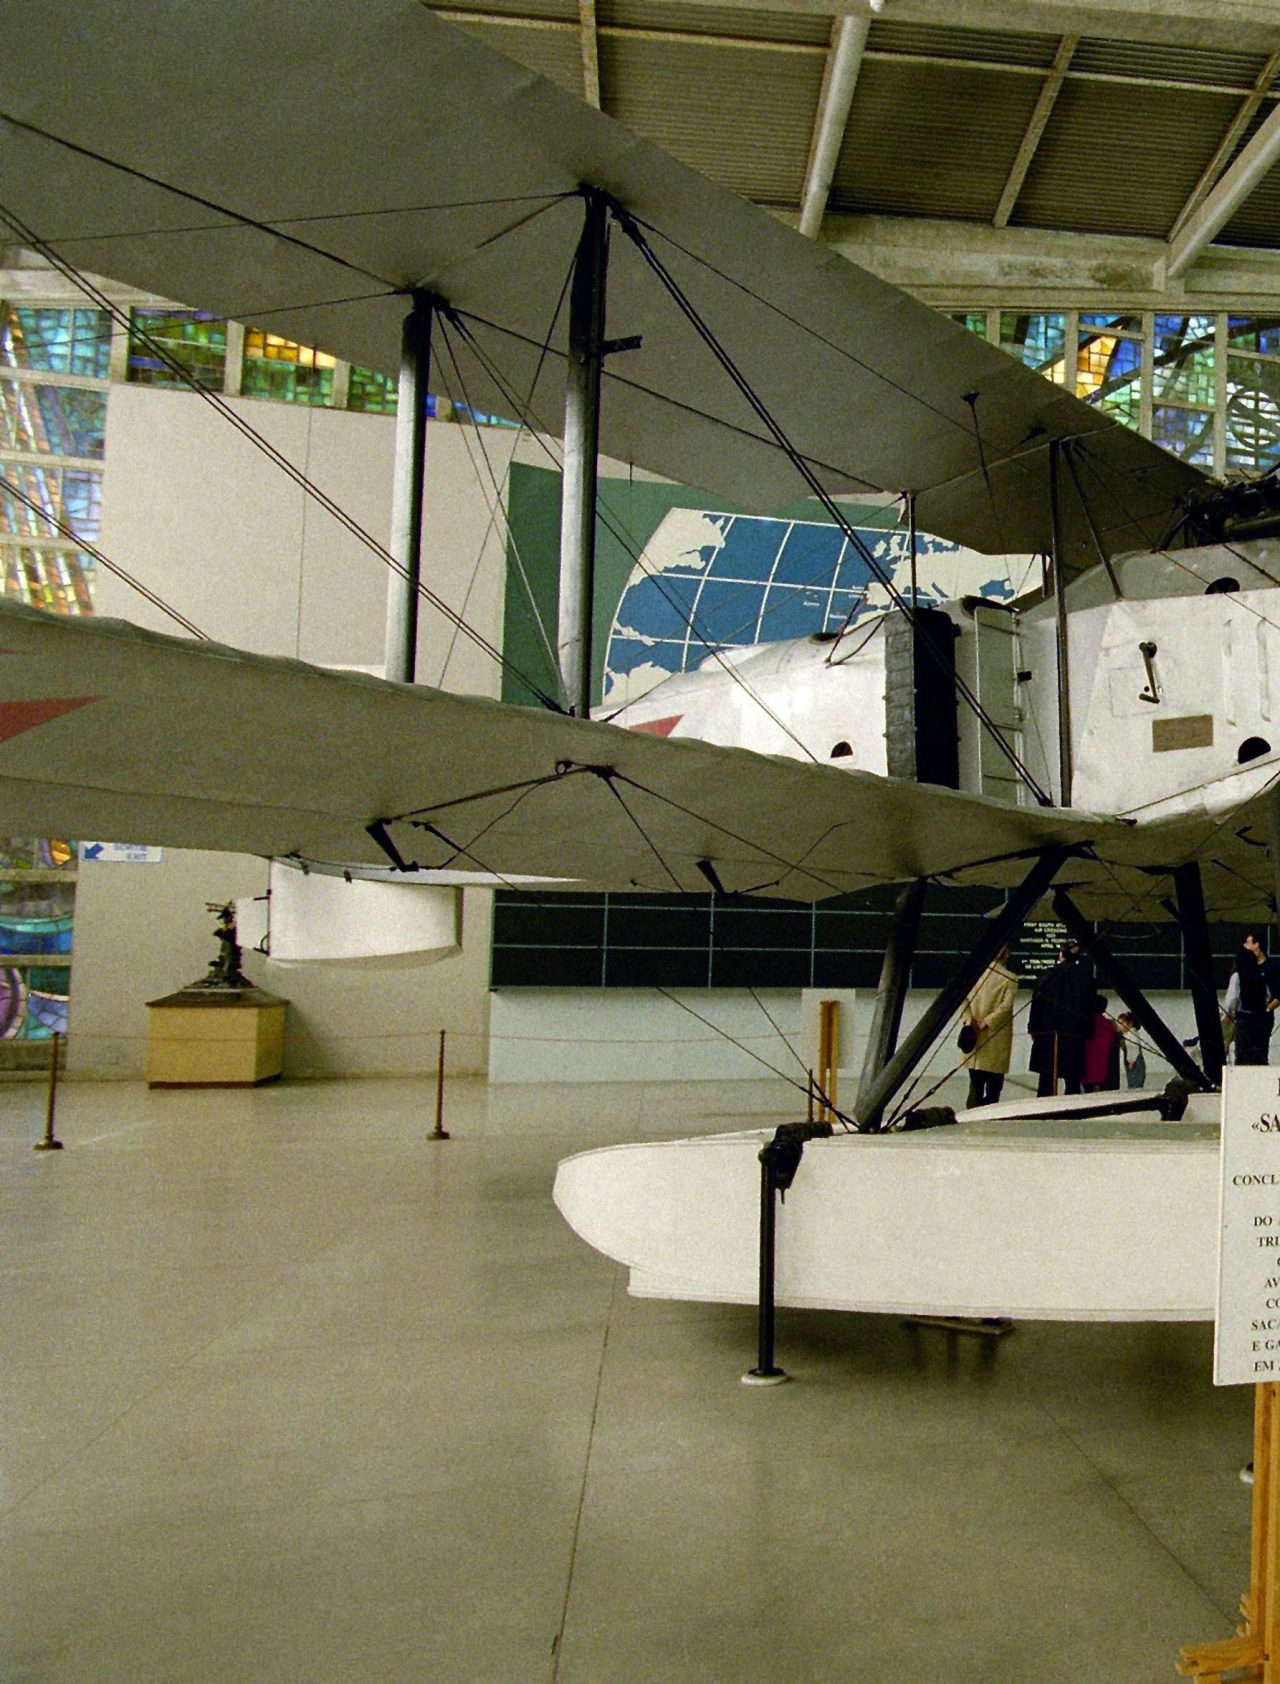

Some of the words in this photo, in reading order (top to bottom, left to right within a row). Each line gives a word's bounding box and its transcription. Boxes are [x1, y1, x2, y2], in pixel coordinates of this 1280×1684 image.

[1253, 1216, 1273, 1227] DO
[1252, 1341, 1261, 1352] E
[1253, 1361, 1274, 1372] EM
